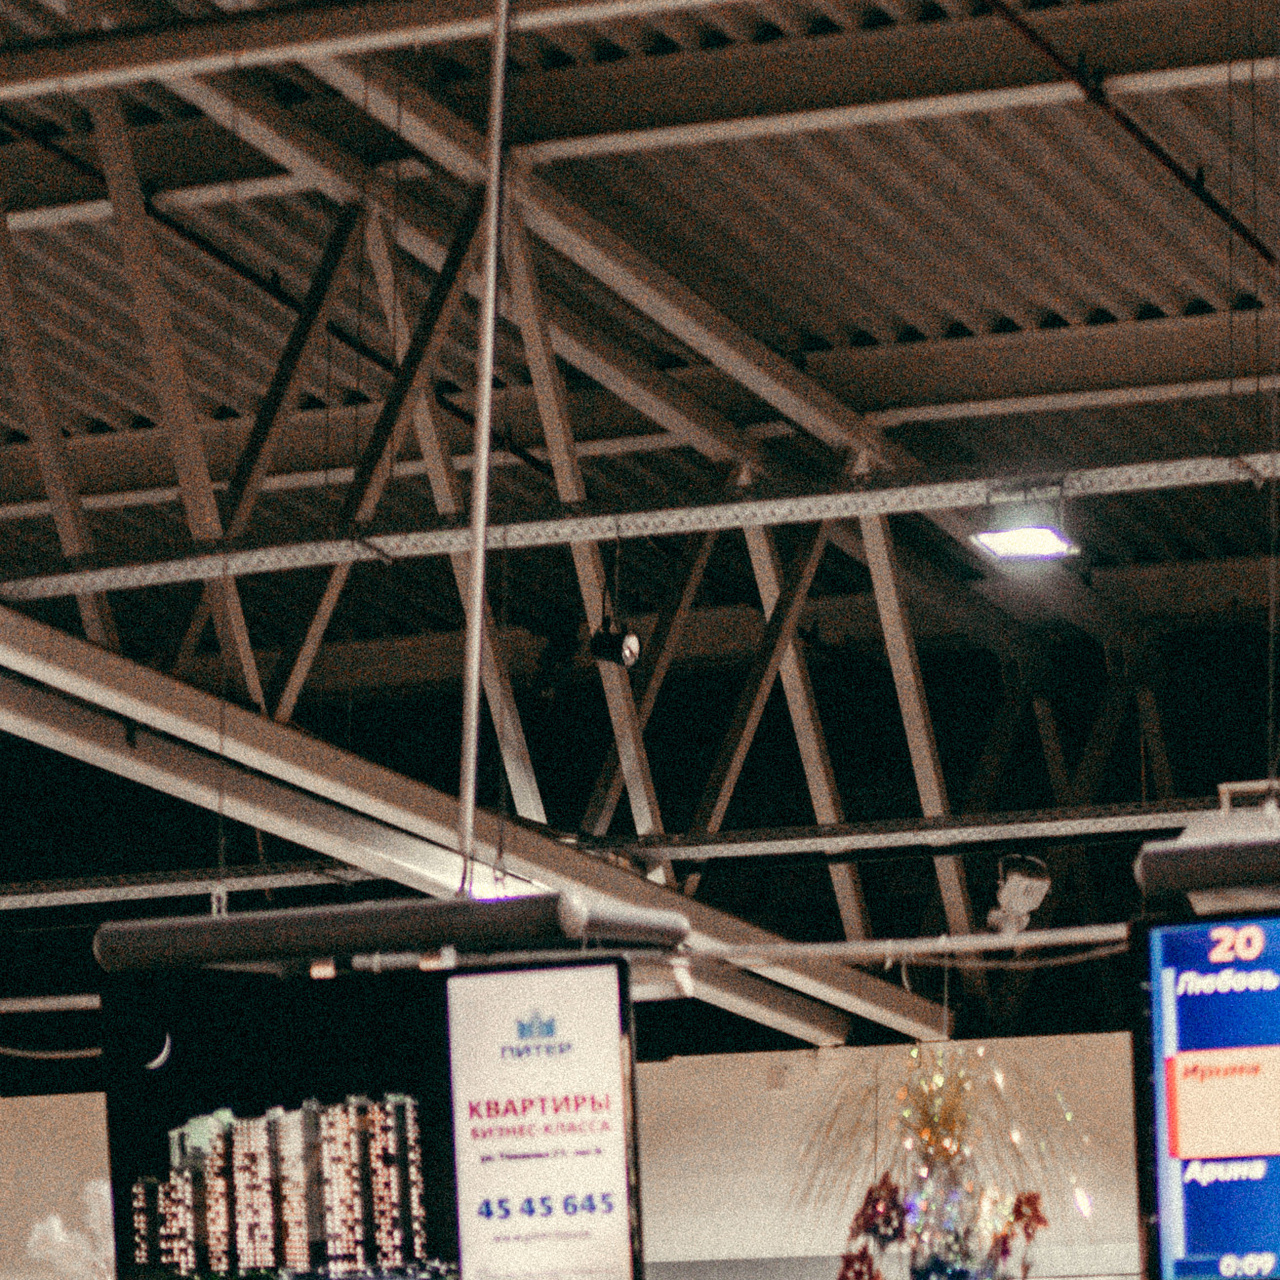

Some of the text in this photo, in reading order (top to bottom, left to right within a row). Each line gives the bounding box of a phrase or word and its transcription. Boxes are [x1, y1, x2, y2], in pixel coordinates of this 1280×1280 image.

[1207, 924, 1266, 963] 20
[468, 1093, 610, 1120] КВАРТИРЫ
[477, 1192, 614, 1221] 45 45 645
